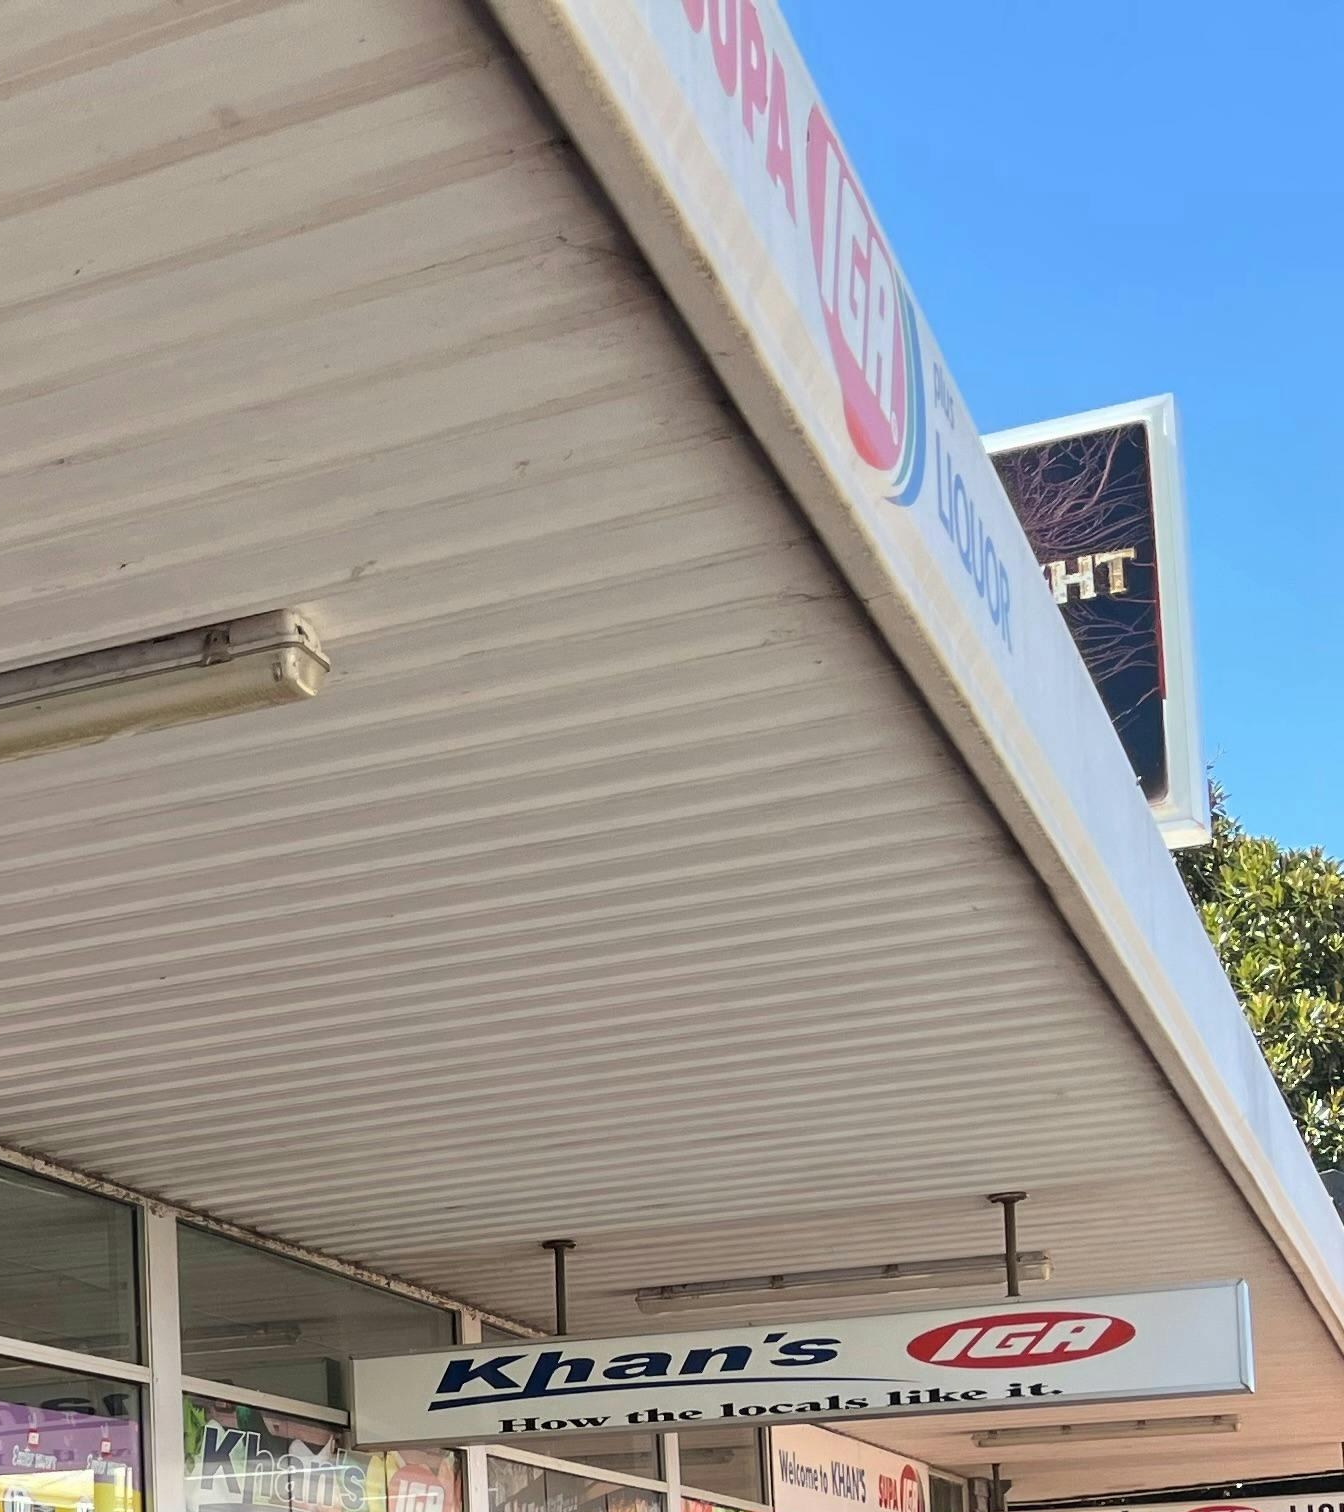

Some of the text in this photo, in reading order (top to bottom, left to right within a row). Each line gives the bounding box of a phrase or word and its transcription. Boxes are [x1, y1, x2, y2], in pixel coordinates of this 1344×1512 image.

[821, 145, 897, 414] IGA
[934, 428, 1014, 655] LIQUOR
[435, 1317, 1113, 1394] Khan's IGA
[499, 1382, 1062, 1433] How the locals like it.
[201, 1424, 366, 1512] Khan's
[779, 1449, 866, 1503] Welcome to KHAN'S
[879, 1474, 898, 1511] SUPA
